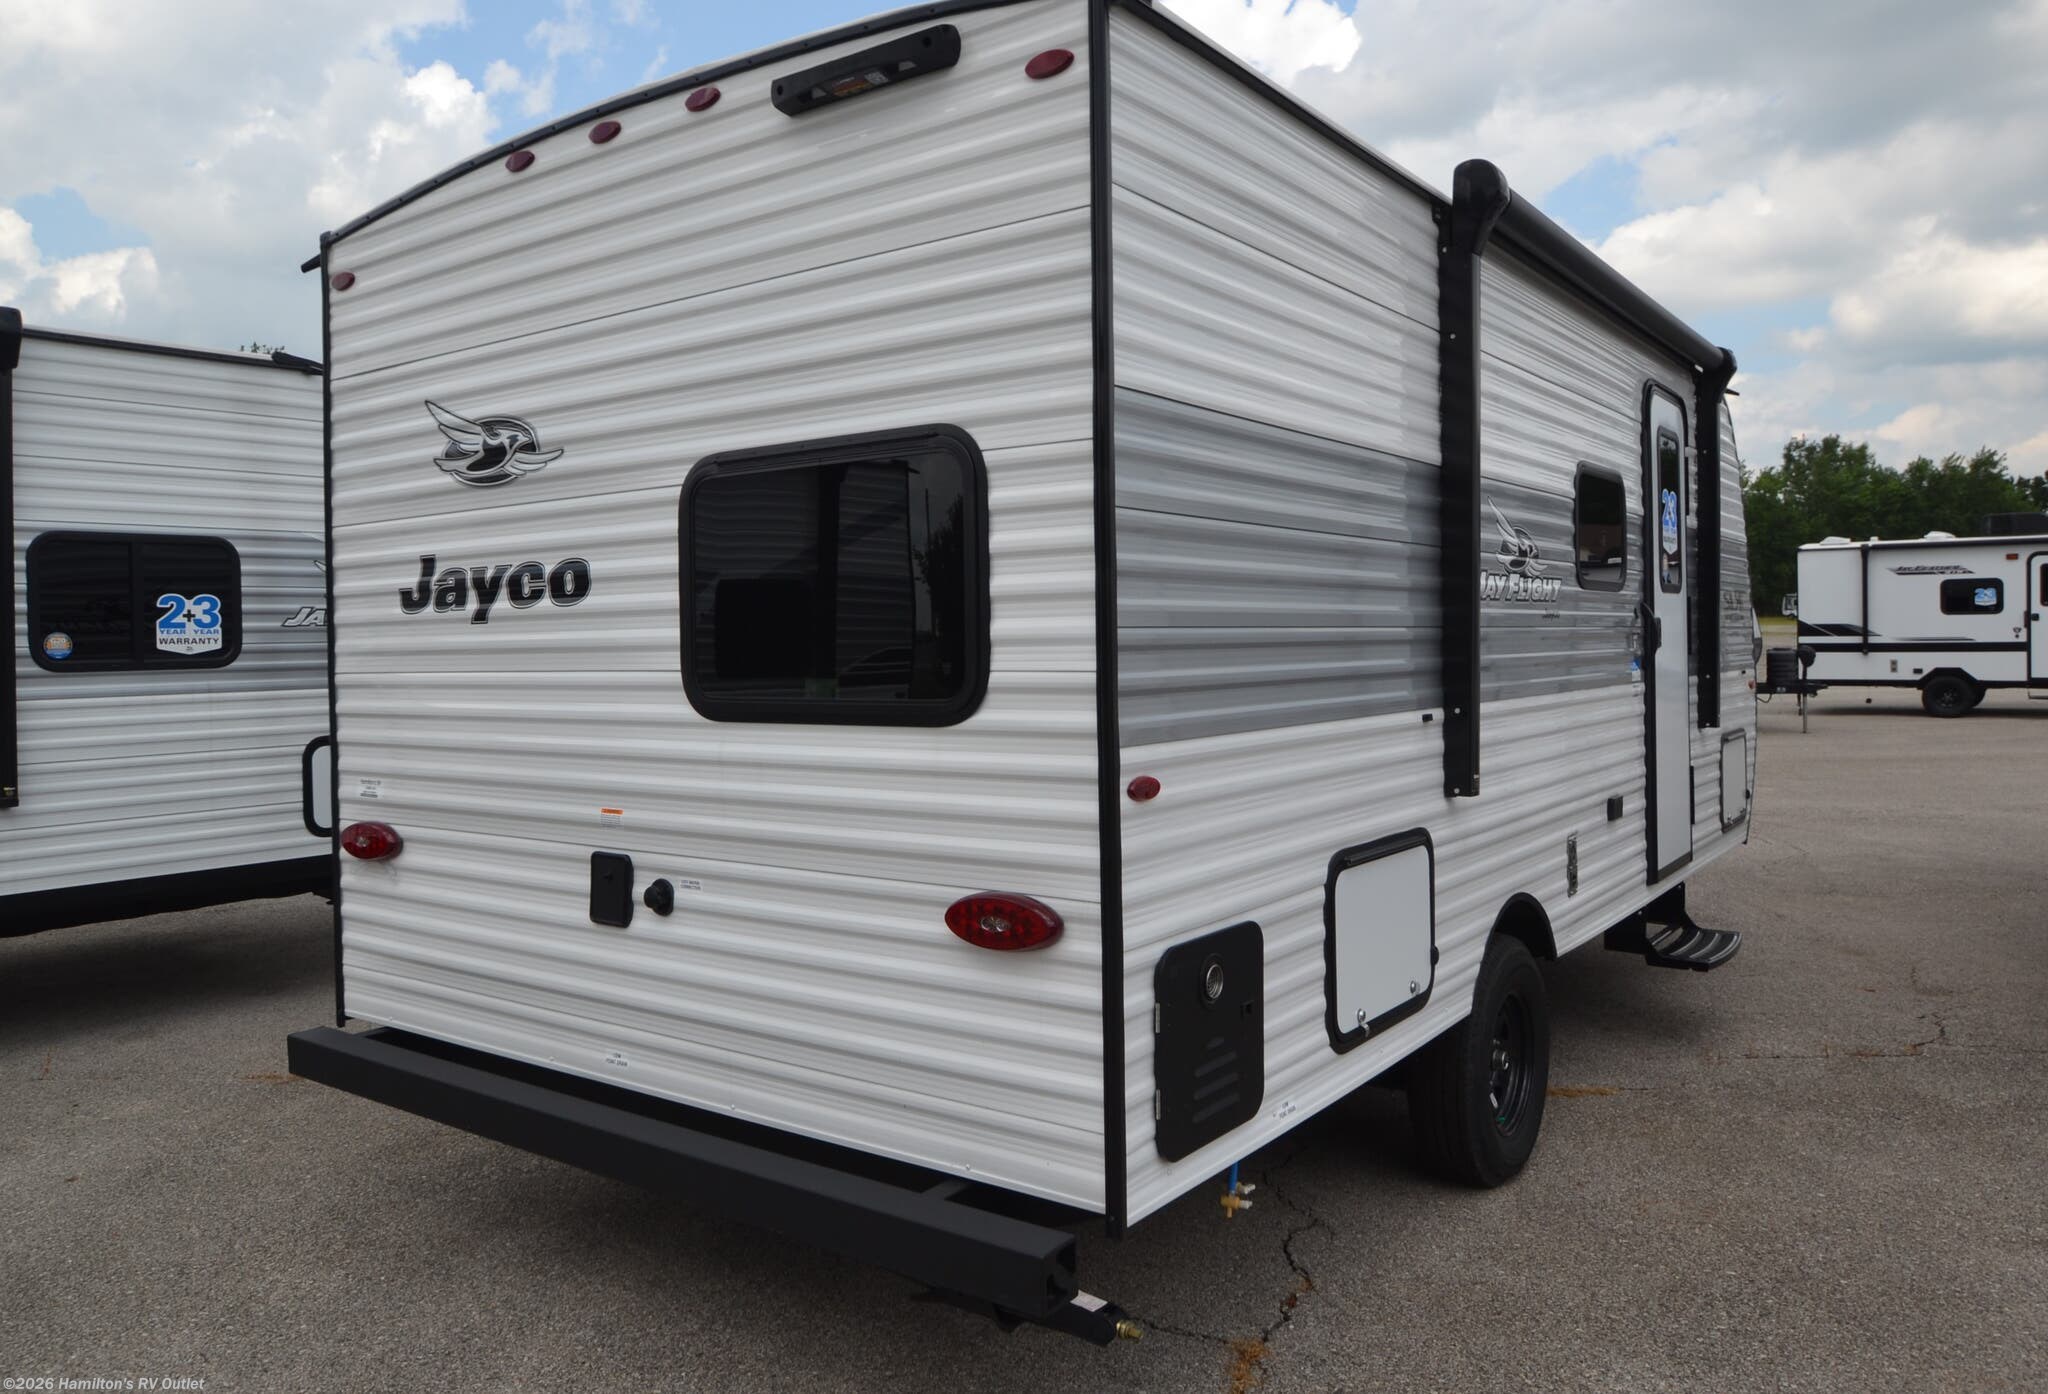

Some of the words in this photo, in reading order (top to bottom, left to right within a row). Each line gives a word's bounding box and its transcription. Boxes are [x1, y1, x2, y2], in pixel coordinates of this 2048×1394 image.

[399, 554, 591, 624] Jayco
[1505, 573, 1562, 602] FLIGHT
[281, 606, 327, 627] JA
[159, 637, 219, 645] WARRANTY
